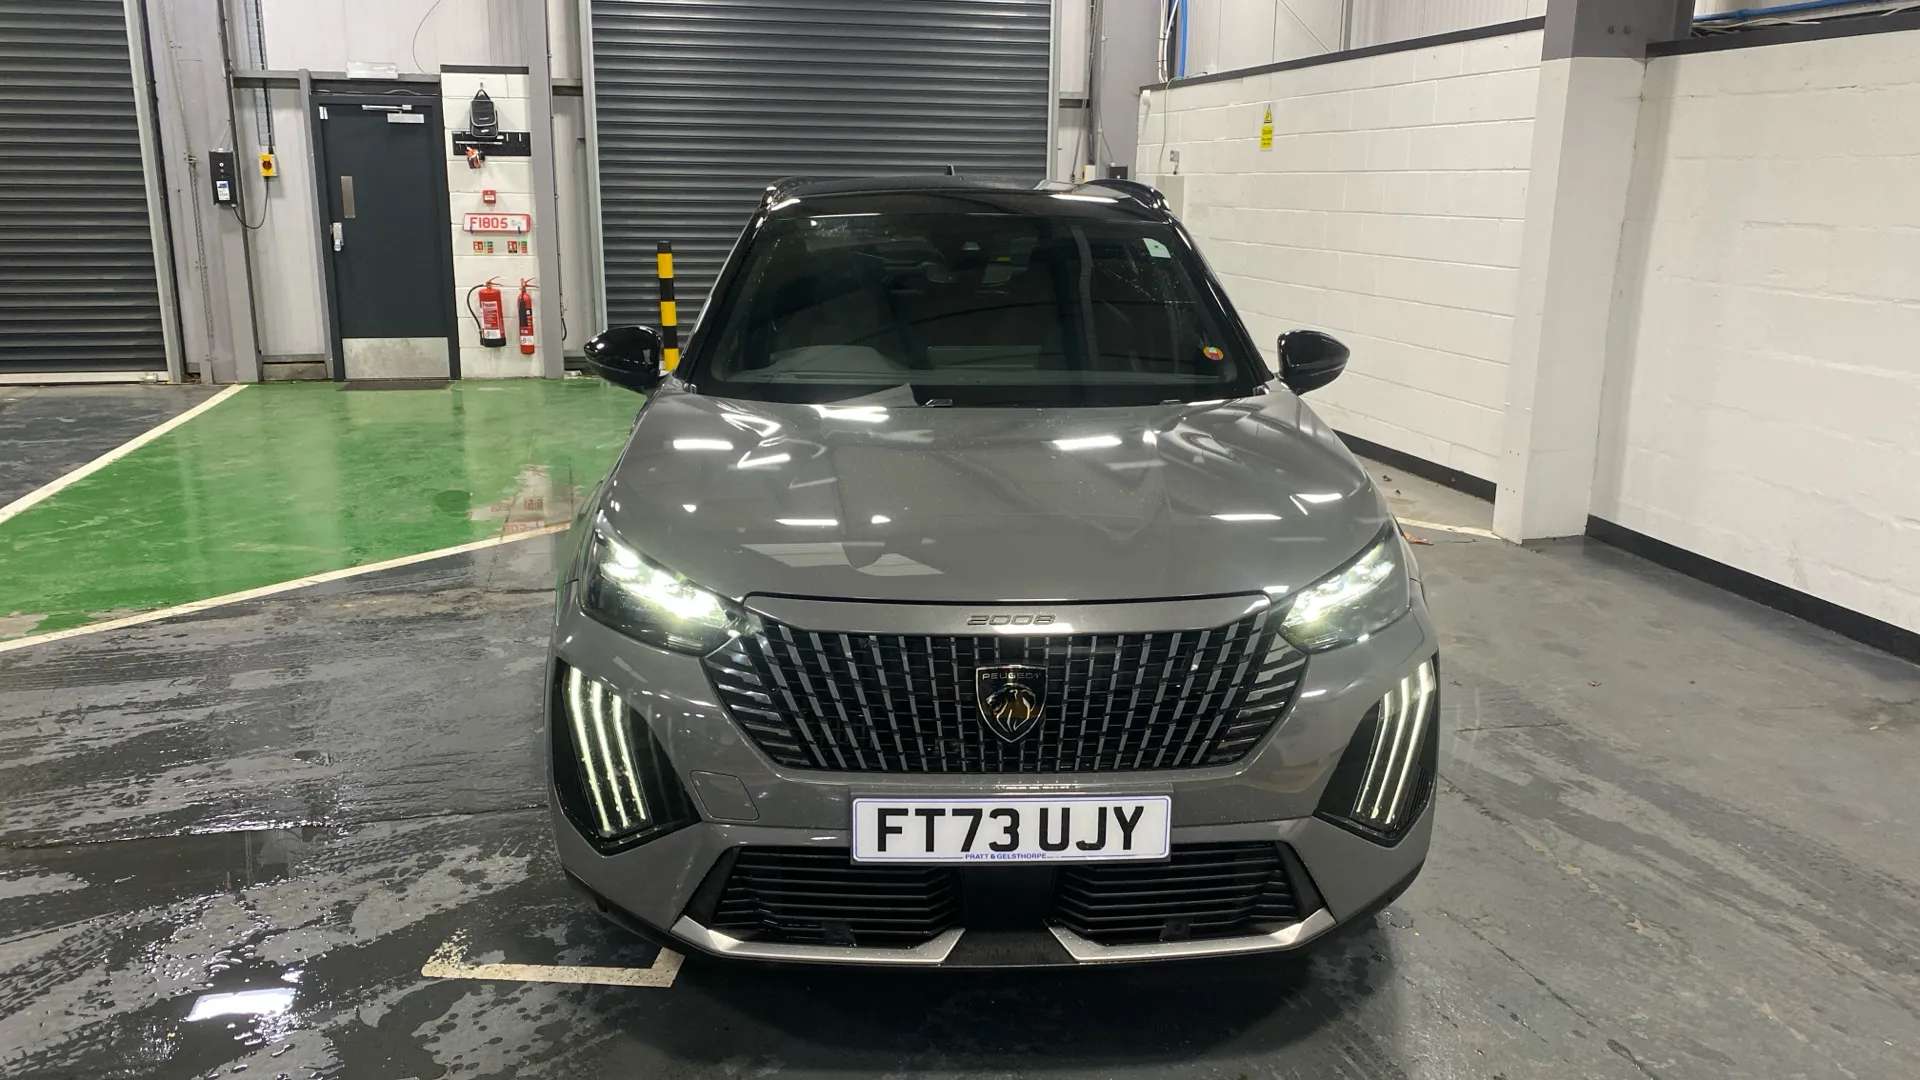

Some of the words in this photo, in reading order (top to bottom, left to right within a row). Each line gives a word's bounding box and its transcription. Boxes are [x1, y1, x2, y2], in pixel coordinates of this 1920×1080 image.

[967, 614, 1056, 626] 2008
[982, 672, 1041, 681] PEUGEOT
[877, 807, 1020, 853] FT73
[1039, 806, 1144, 852] UJY
[997, 852, 1047, 860] GELSTHORPE
